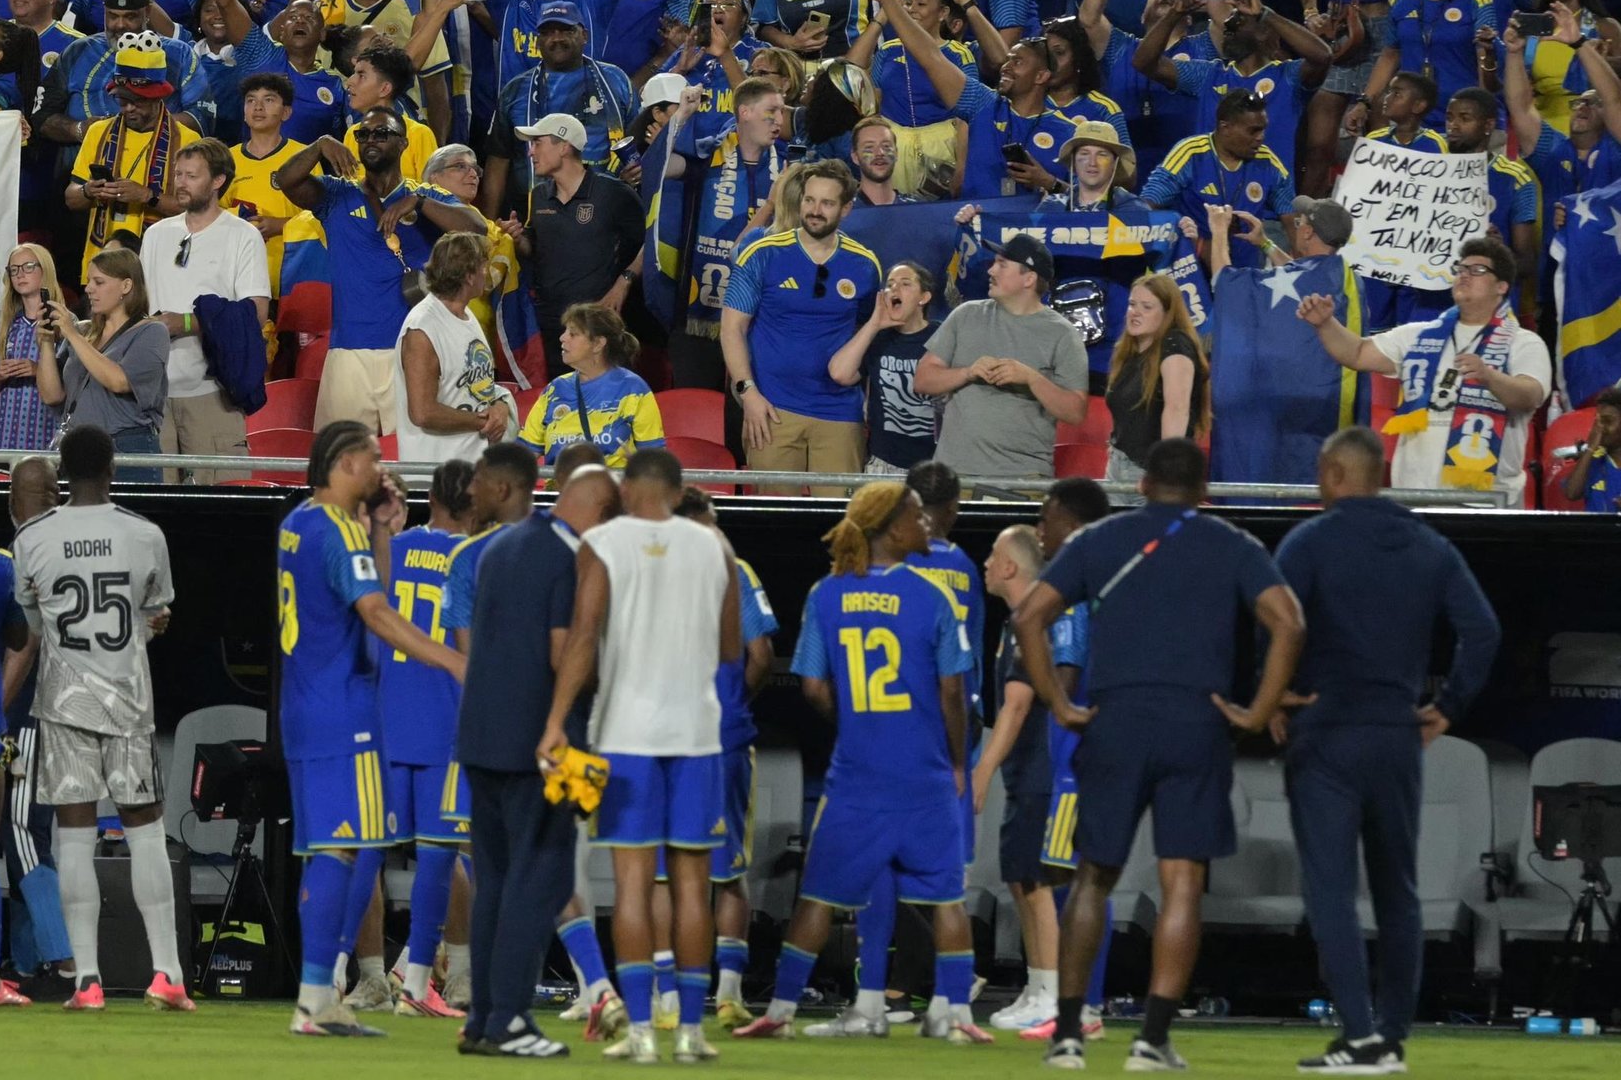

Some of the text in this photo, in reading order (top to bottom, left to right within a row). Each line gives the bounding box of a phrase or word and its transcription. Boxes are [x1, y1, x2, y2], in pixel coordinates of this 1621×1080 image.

[1369, 178, 1428, 204] MADE
[696, 244, 731, 260] CURAÇ
[63, 538, 112, 559] BODAK
[51, 570, 133, 652] 25
[842, 591, 901, 616] HANSEN
[839, 627, 912, 712] 12
